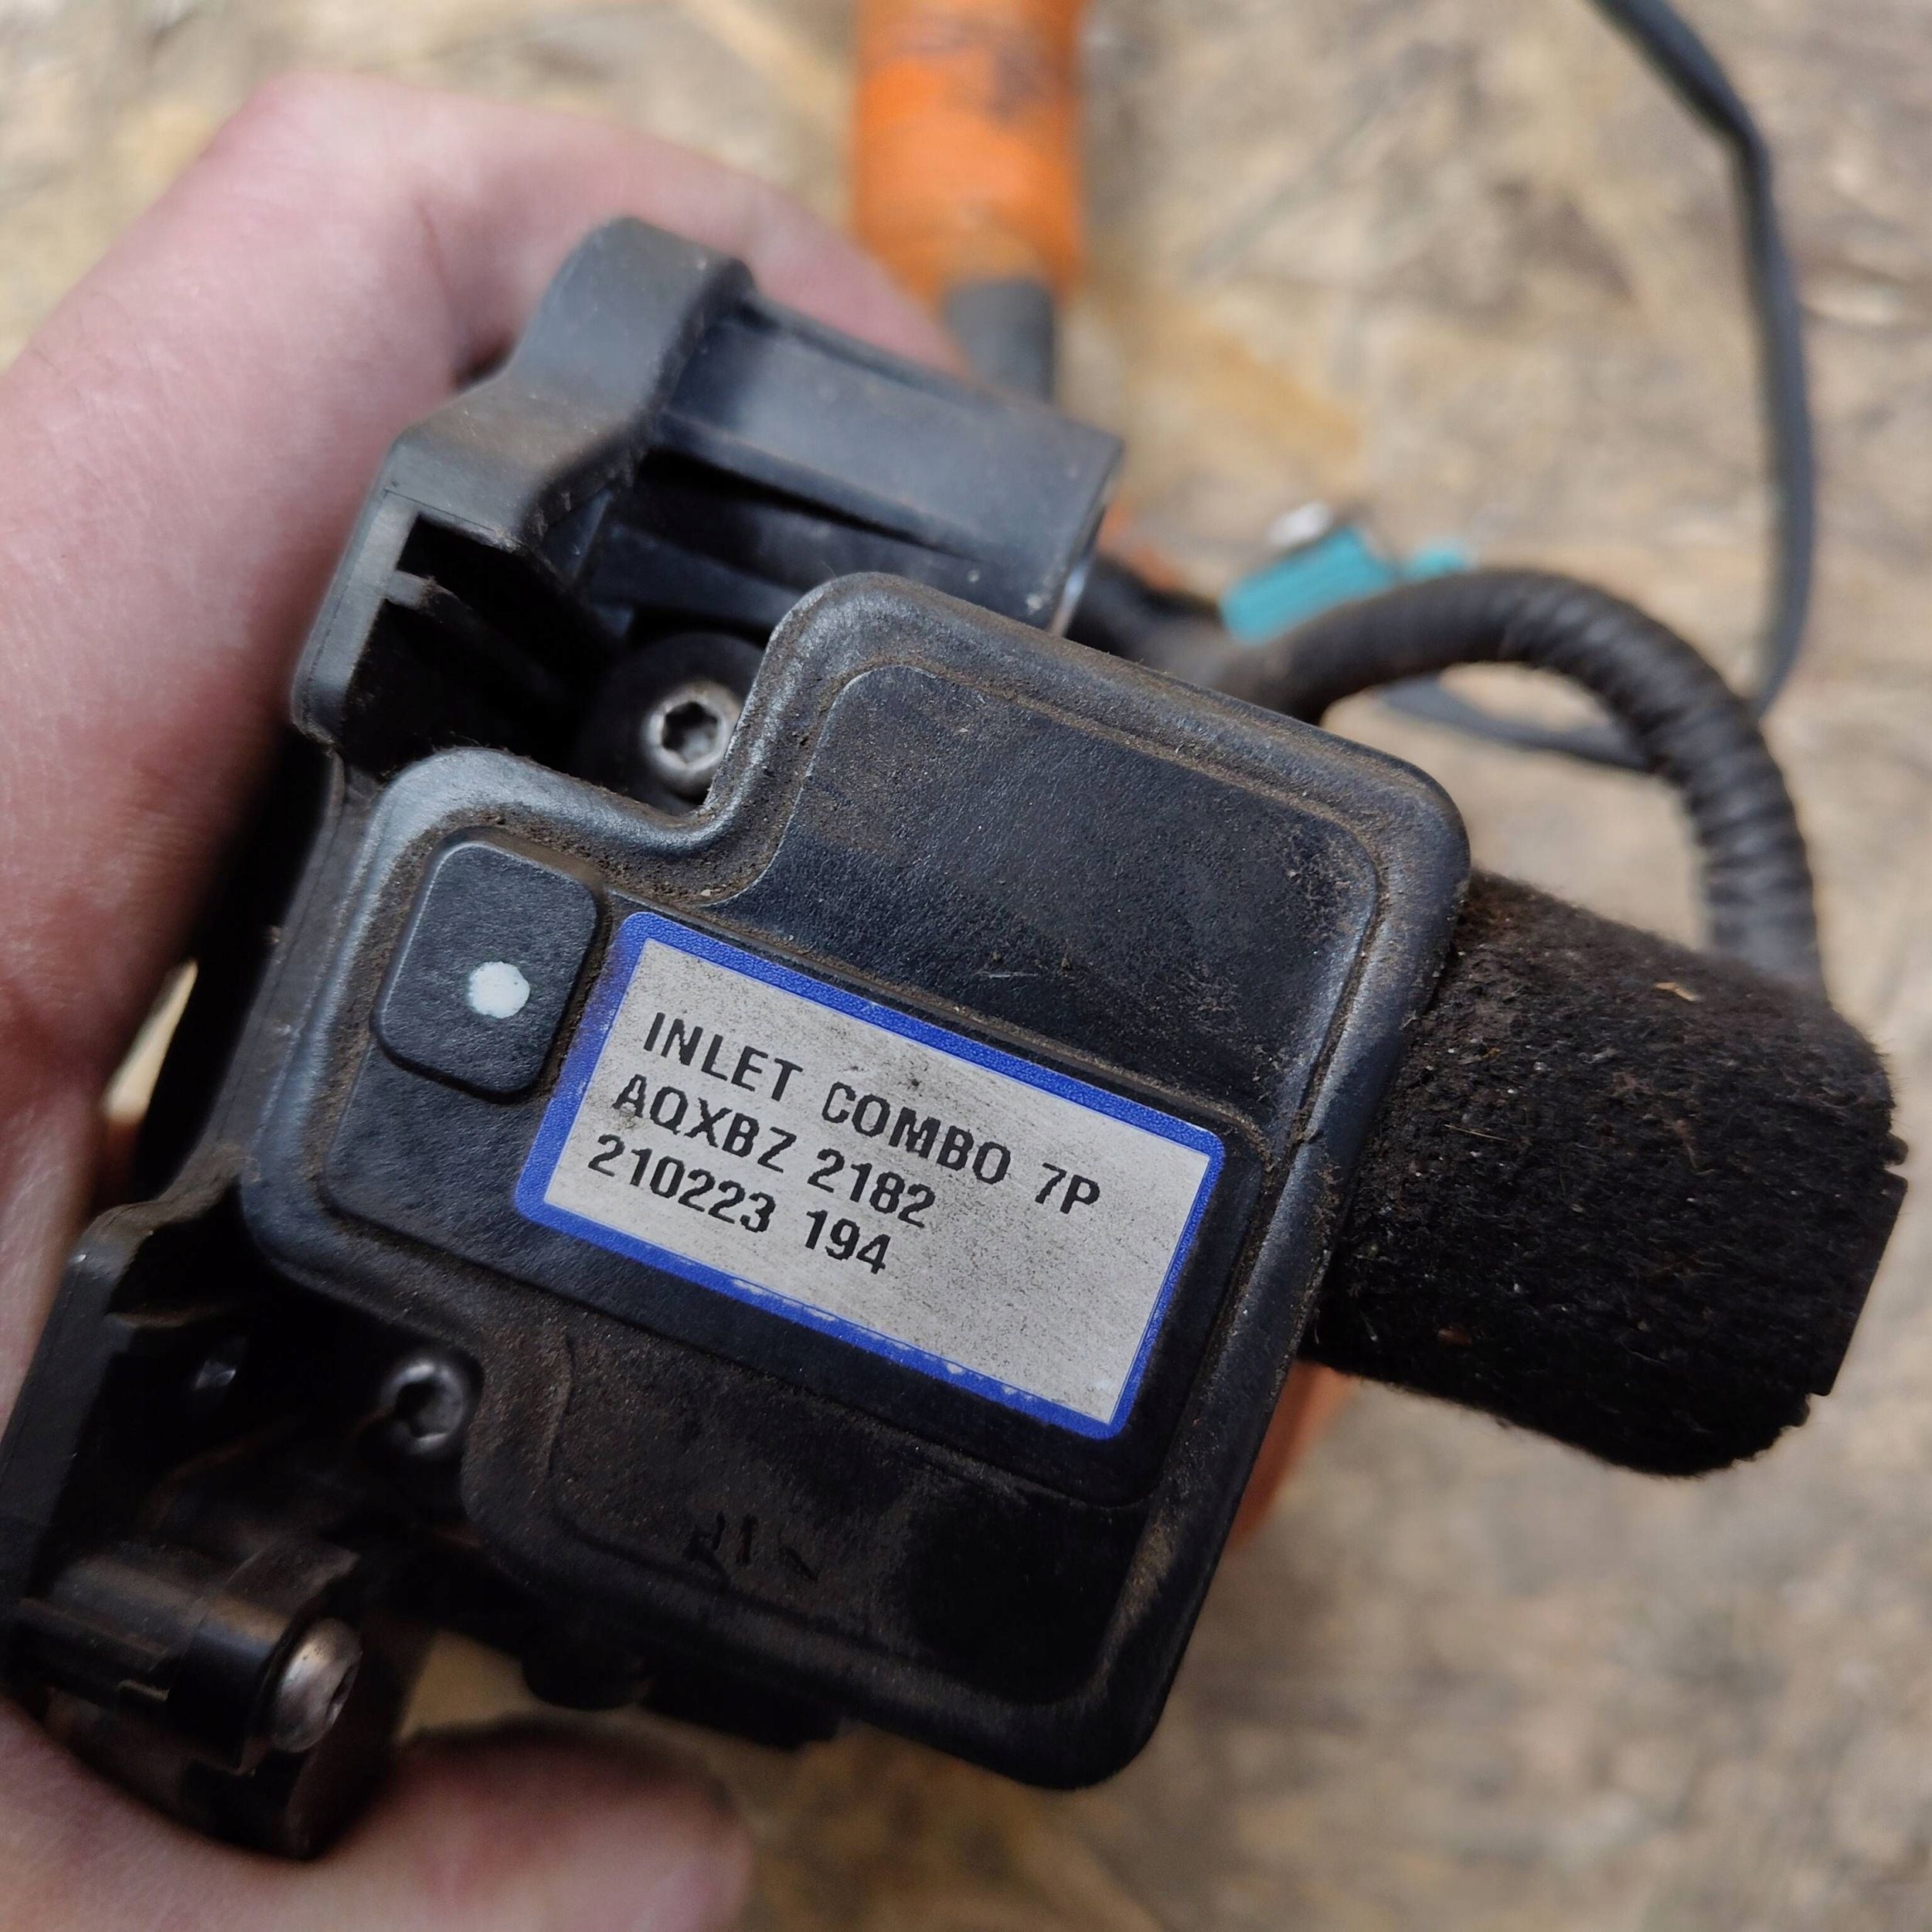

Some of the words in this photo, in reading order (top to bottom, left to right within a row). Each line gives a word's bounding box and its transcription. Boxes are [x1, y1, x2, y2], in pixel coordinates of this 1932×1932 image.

[612, 1073, 797, 1172] AQXBZ
[808, 1147, 937, 1228] 2182
[642, 1011, 803, 1102] INLET
[821, 1082, 1012, 1186] COMBO
[1034, 1162, 1102, 1216] 7P
[587, 1134, 777, 1234] 210223
[804, 1209, 893, 1275] 194
